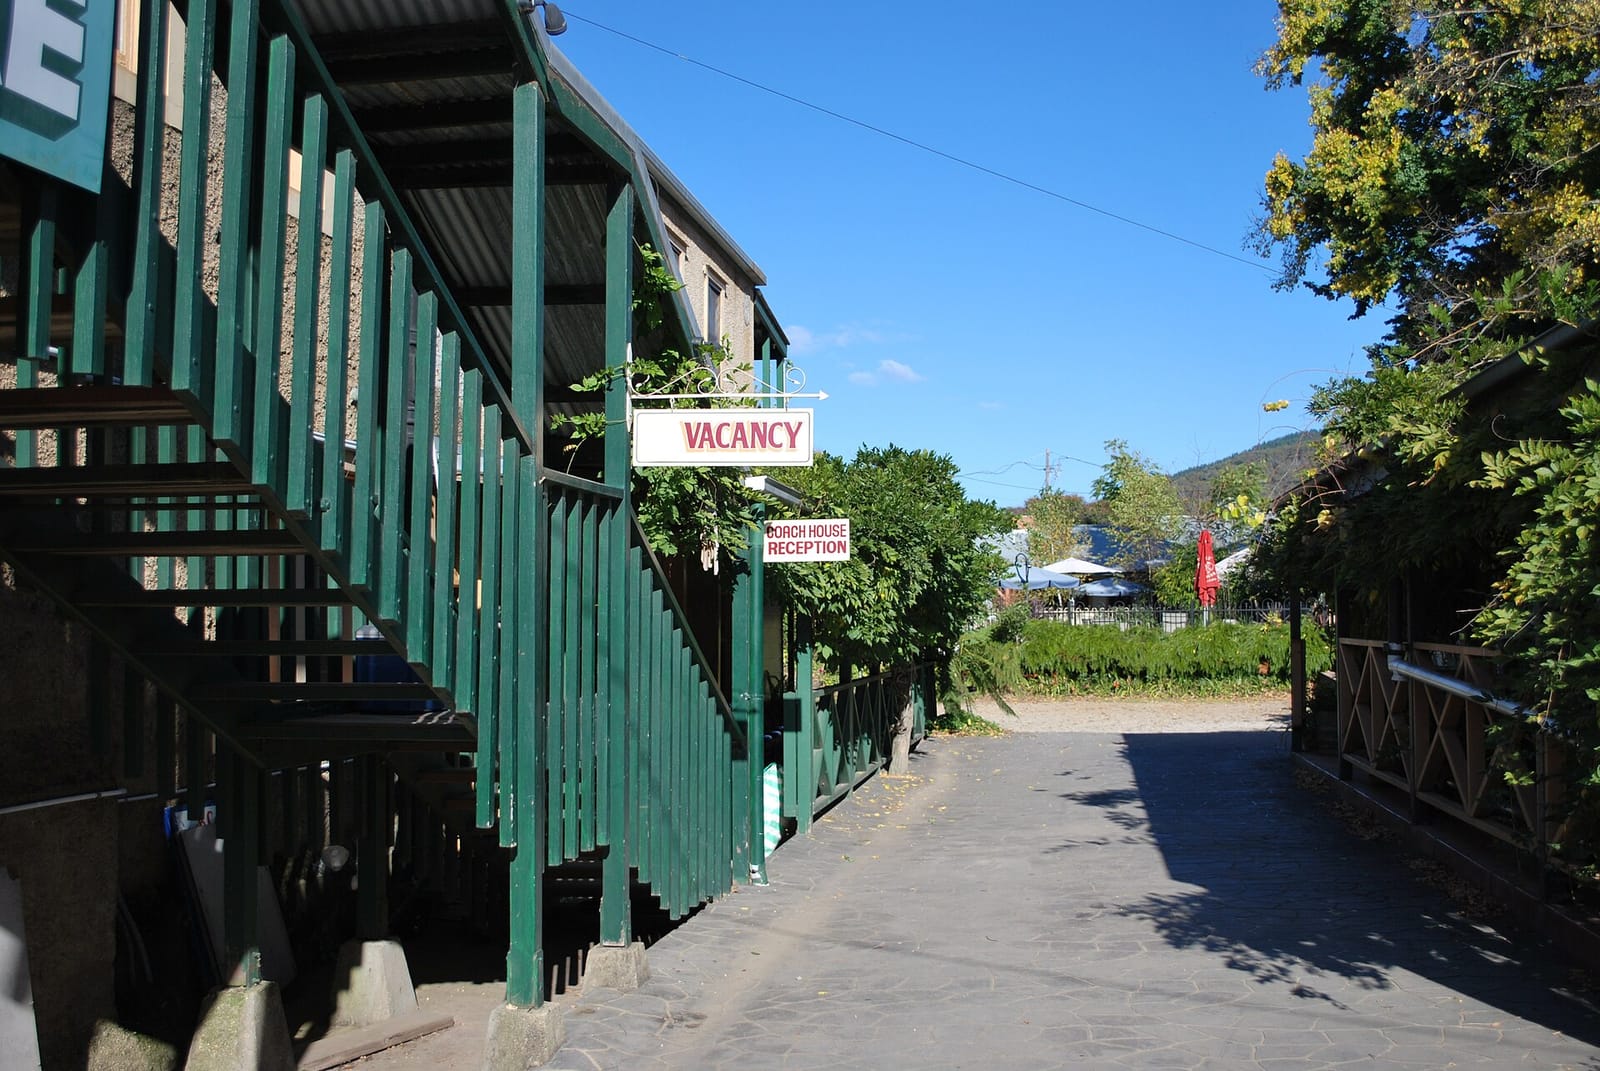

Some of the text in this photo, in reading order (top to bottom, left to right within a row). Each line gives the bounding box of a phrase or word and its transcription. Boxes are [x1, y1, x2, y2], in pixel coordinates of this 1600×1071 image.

[0, 0, 87, 122] E
[682, 421, 803, 450] VACANCY
[766, 523, 847, 539] COACH HOUSE
[768, 540, 847, 555] RECEPTION
